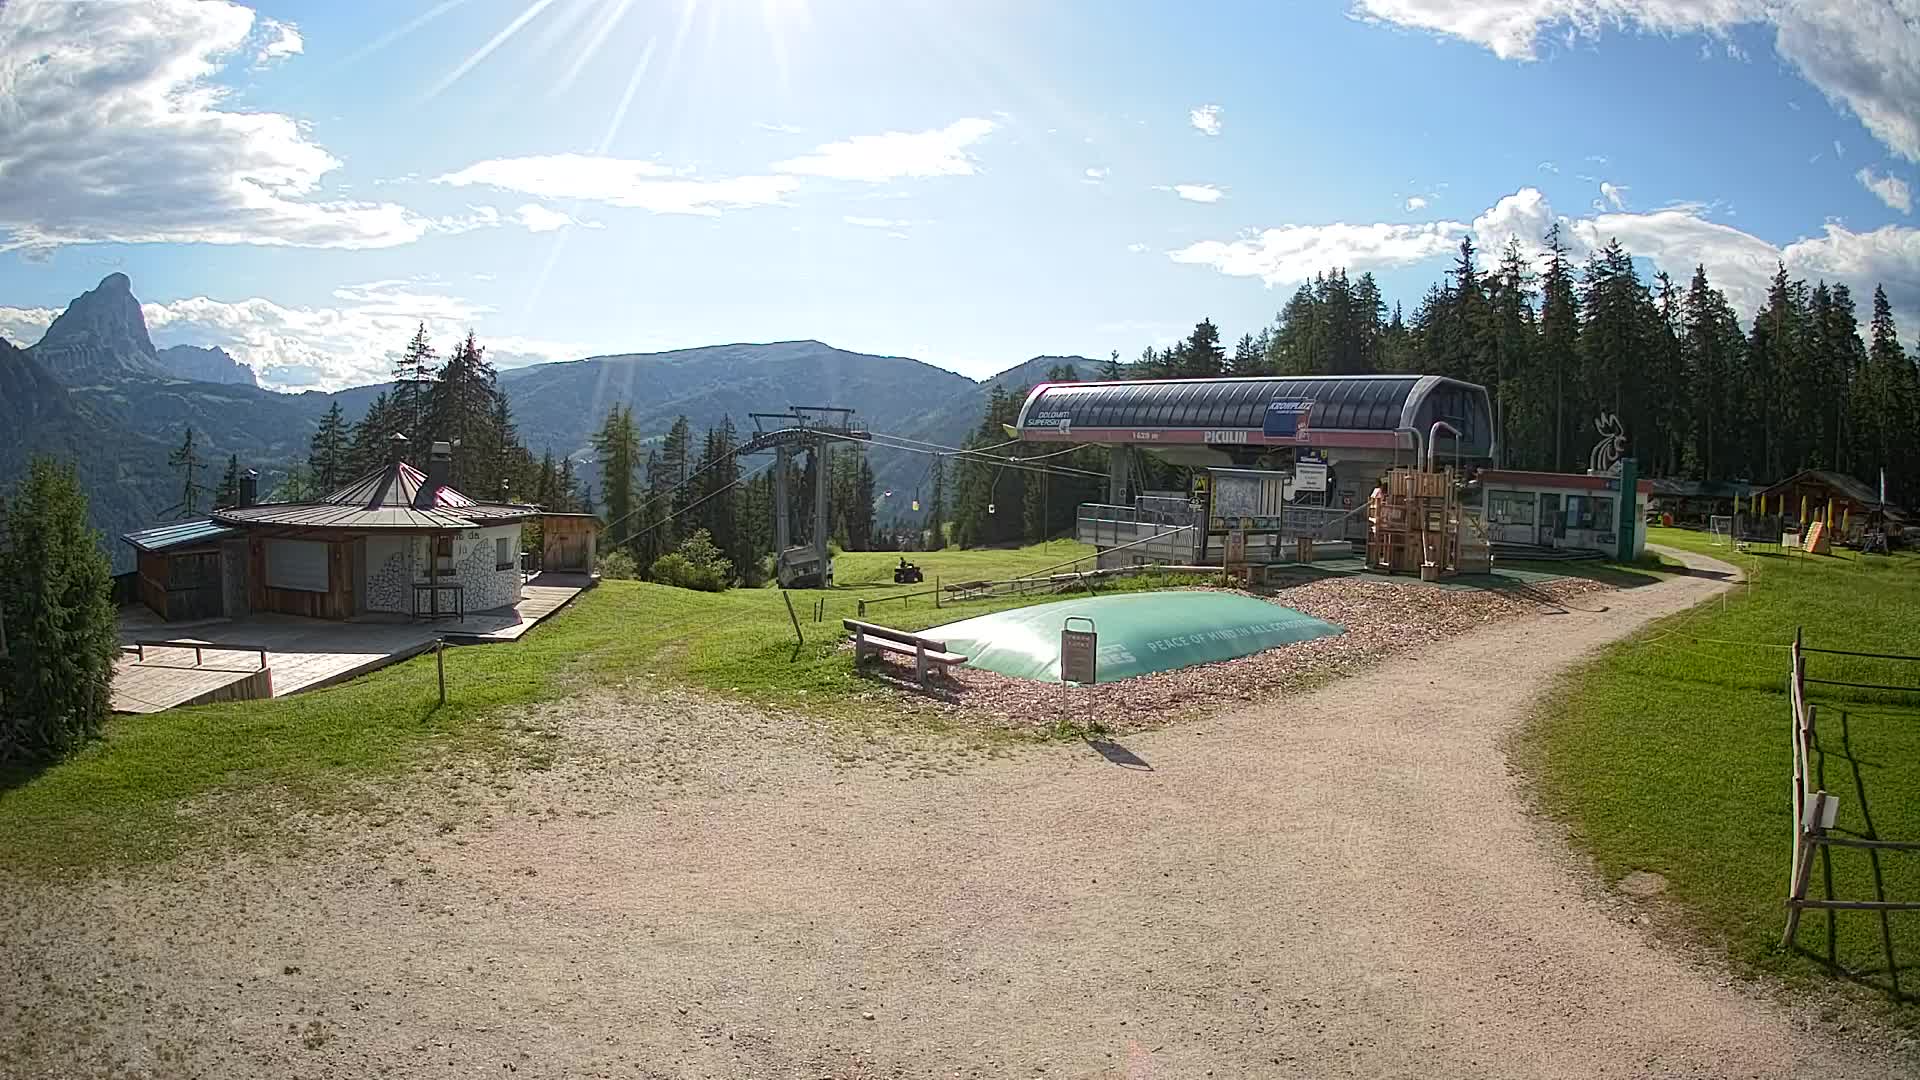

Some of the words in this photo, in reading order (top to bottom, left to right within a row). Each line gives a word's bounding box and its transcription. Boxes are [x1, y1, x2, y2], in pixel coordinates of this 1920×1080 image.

[1203, 431, 1248, 443] PICULIN
[1146, 636, 1190, 653] PEACE
[1190, 633, 1205, 644] OF
[1207, 629, 1237, 641] MIND
